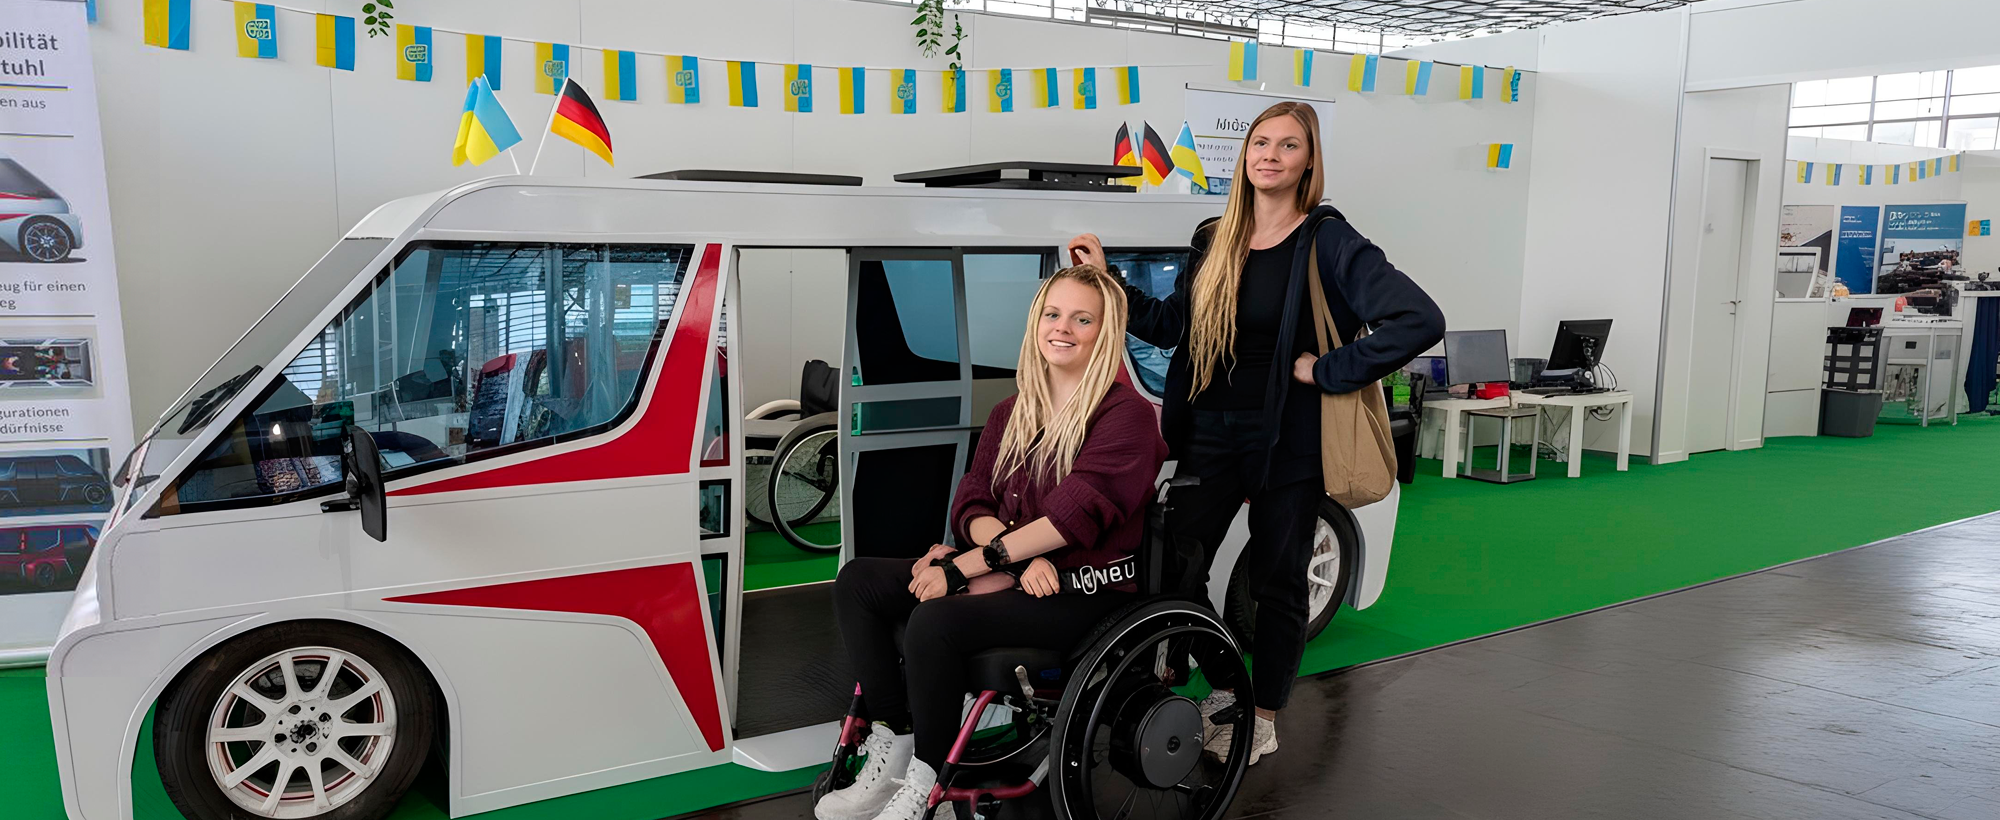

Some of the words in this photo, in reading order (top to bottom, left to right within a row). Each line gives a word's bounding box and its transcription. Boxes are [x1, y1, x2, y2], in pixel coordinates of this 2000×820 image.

[0, 59, 45, 76] tuhl
[22, 99, 46, 109] aus
[24, 280, 43, 292] für
[46, 280, 87, 292] einen
